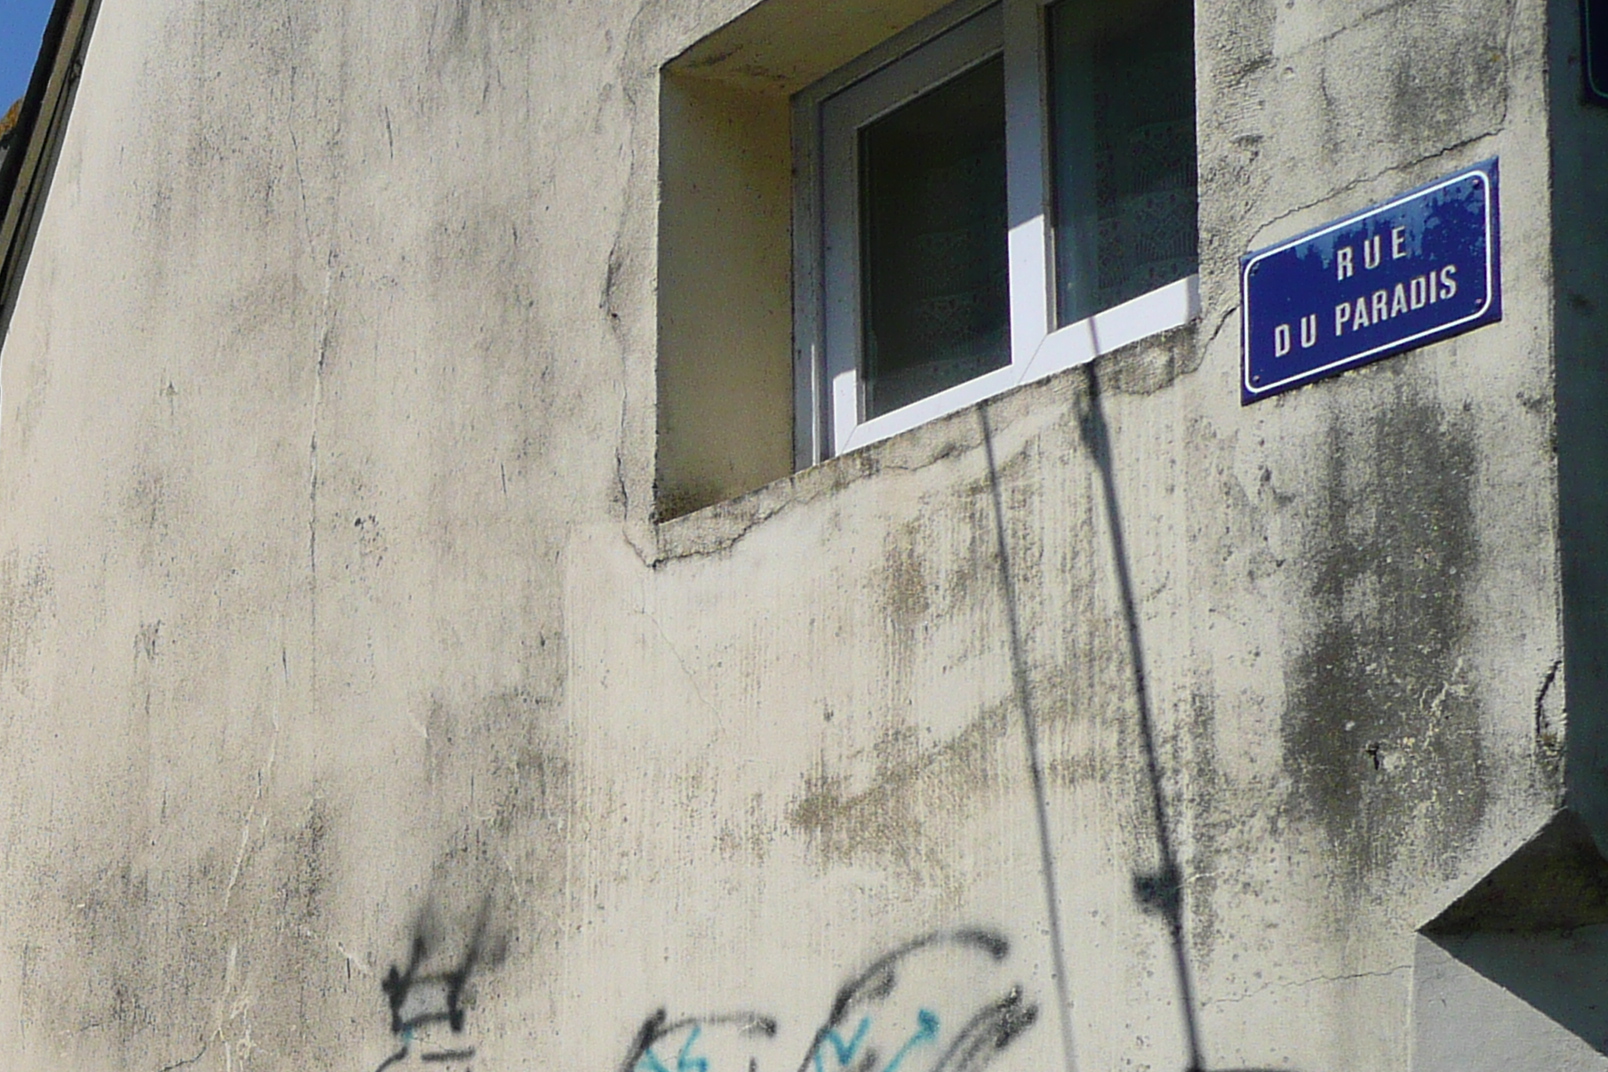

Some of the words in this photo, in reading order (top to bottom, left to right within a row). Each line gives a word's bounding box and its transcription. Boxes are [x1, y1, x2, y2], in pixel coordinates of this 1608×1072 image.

[1337, 225, 1407, 281] RUE
[1273, 313, 1318, 358] DU
[1334, 263, 1458, 337] PARADIS
